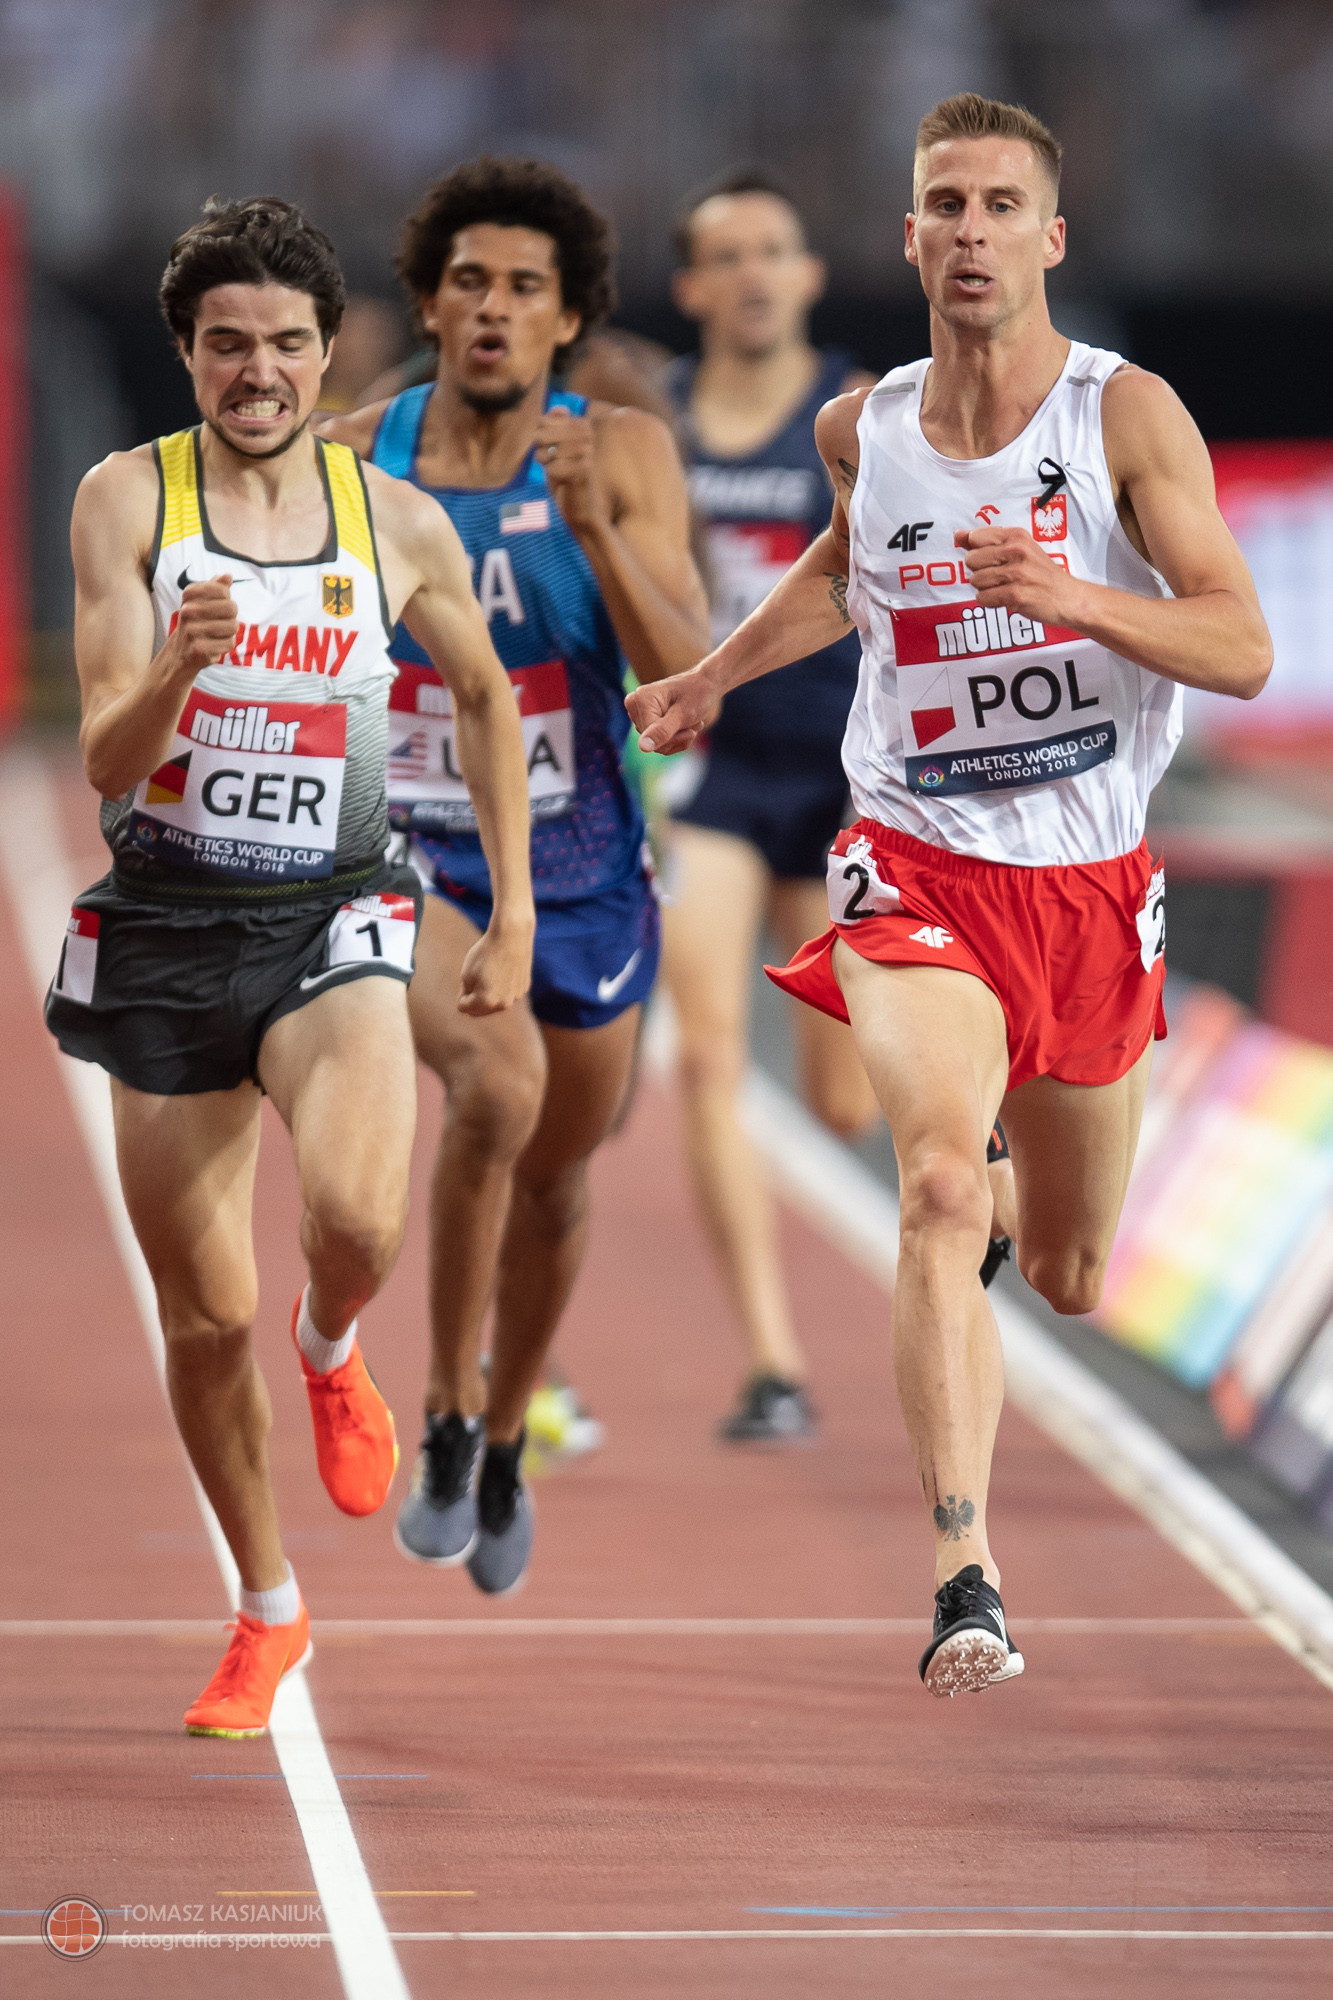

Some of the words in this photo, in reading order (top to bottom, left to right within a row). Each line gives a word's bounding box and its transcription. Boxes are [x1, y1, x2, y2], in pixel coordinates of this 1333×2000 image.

[887, 521, 934, 552] 4F
[168, 610, 359, 677] RMANY
[935, 605, 1046, 657] müller
[967, 660, 1100, 729] POL
[189, 705, 301, 754] müller
[950, 752, 1022, 775] ATHLETICS
[1023, 740, 1078, 765] WORLD
[1080, 732, 1109, 751] CUP
[441, 731, 562, 781] UA
[987, 764, 1042, 782] LONDON
[1047, 756, 1077, 772] 2018
[201, 768, 326, 826] GER
[162, 827, 235, 855] ATHLETICS
[237, 843, 291, 862] WORLD
[293, 850, 324, 865] CUP
[193, 851, 250, 868] LONDON
[253, 860, 286, 873] 2018
[842, 862, 876, 920] 2
[355, 919, 383, 957] 1
